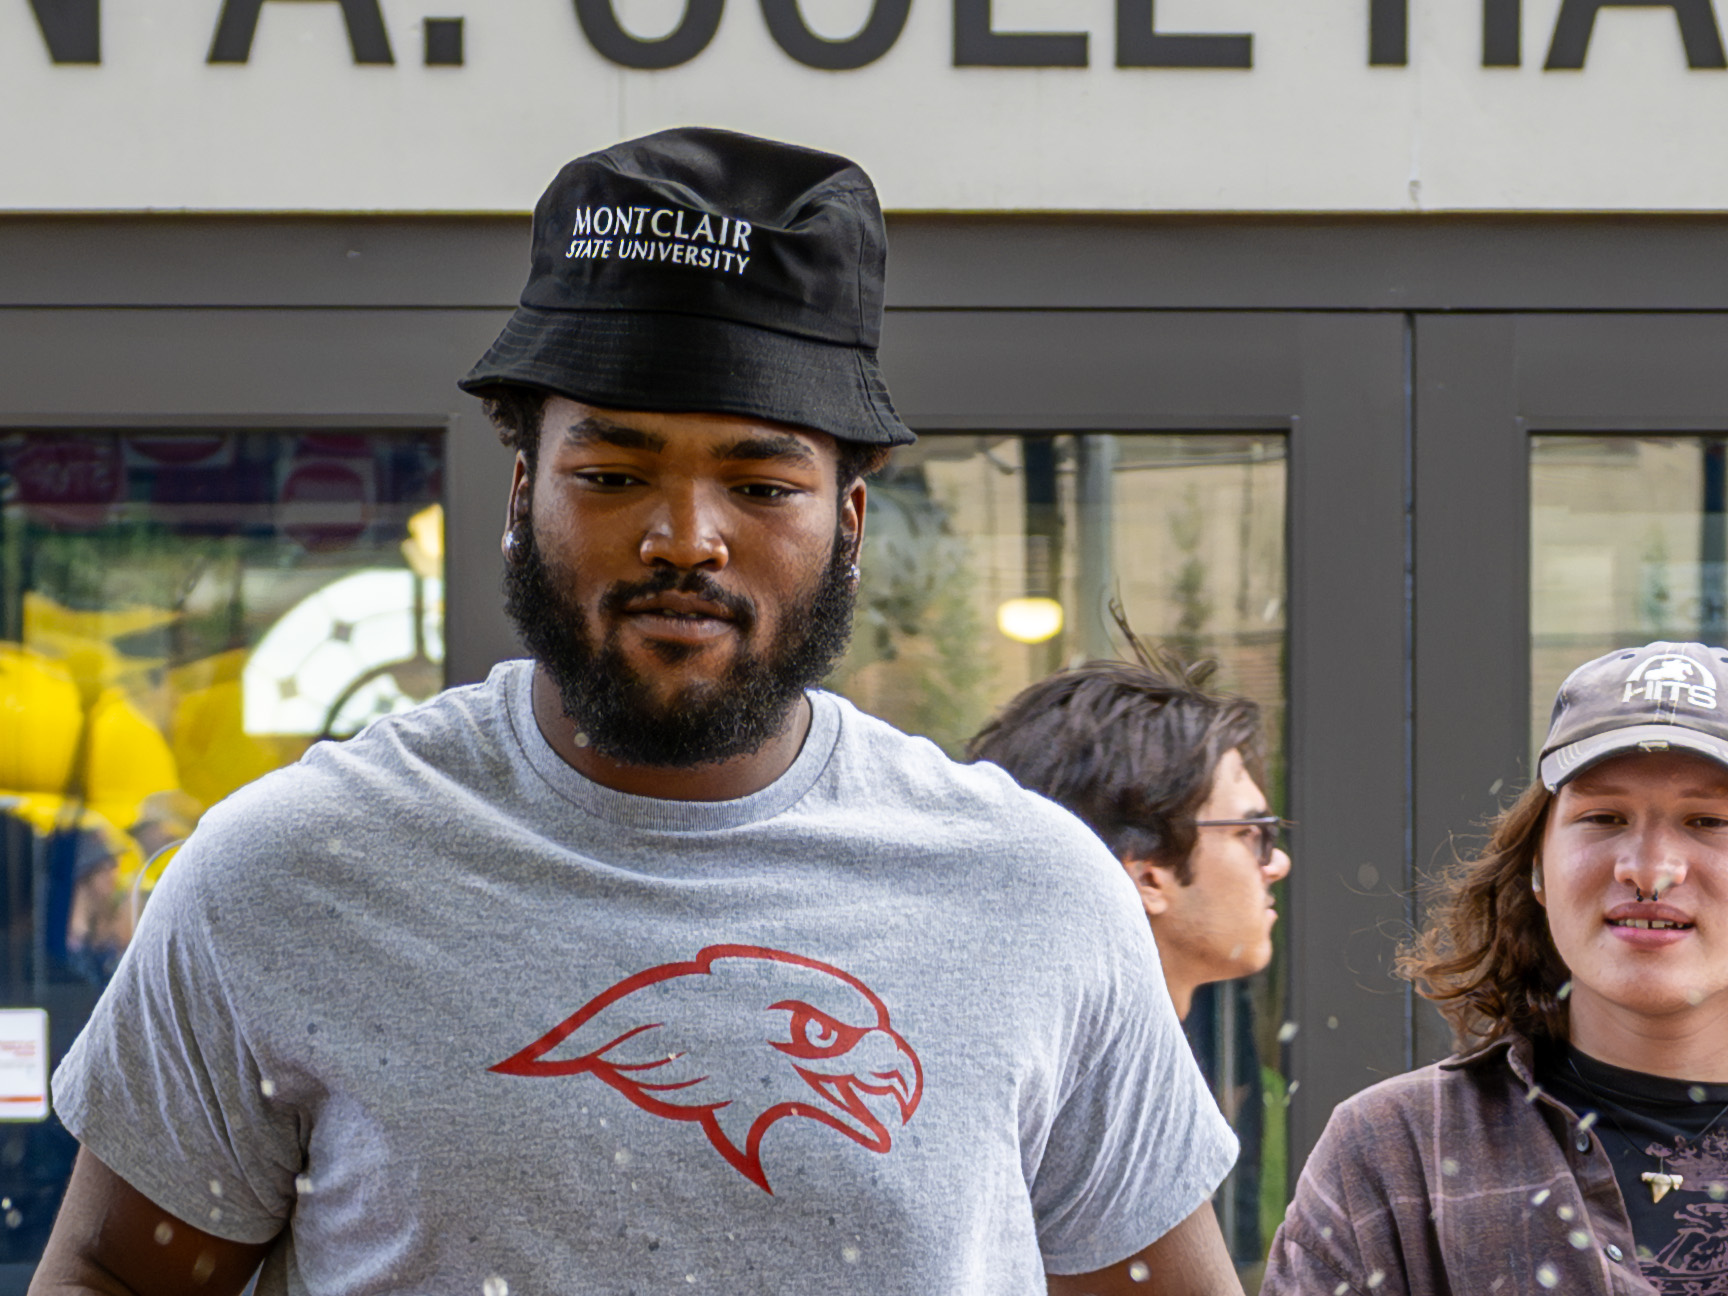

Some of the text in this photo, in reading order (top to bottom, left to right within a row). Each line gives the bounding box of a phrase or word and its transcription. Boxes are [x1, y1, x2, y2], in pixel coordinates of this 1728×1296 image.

[572, 206, 752, 251] MONTCLAIR
[565, 238, 750, 275] STATE UNIVERSITY
[1621, 679, 1717, 710] HITS
